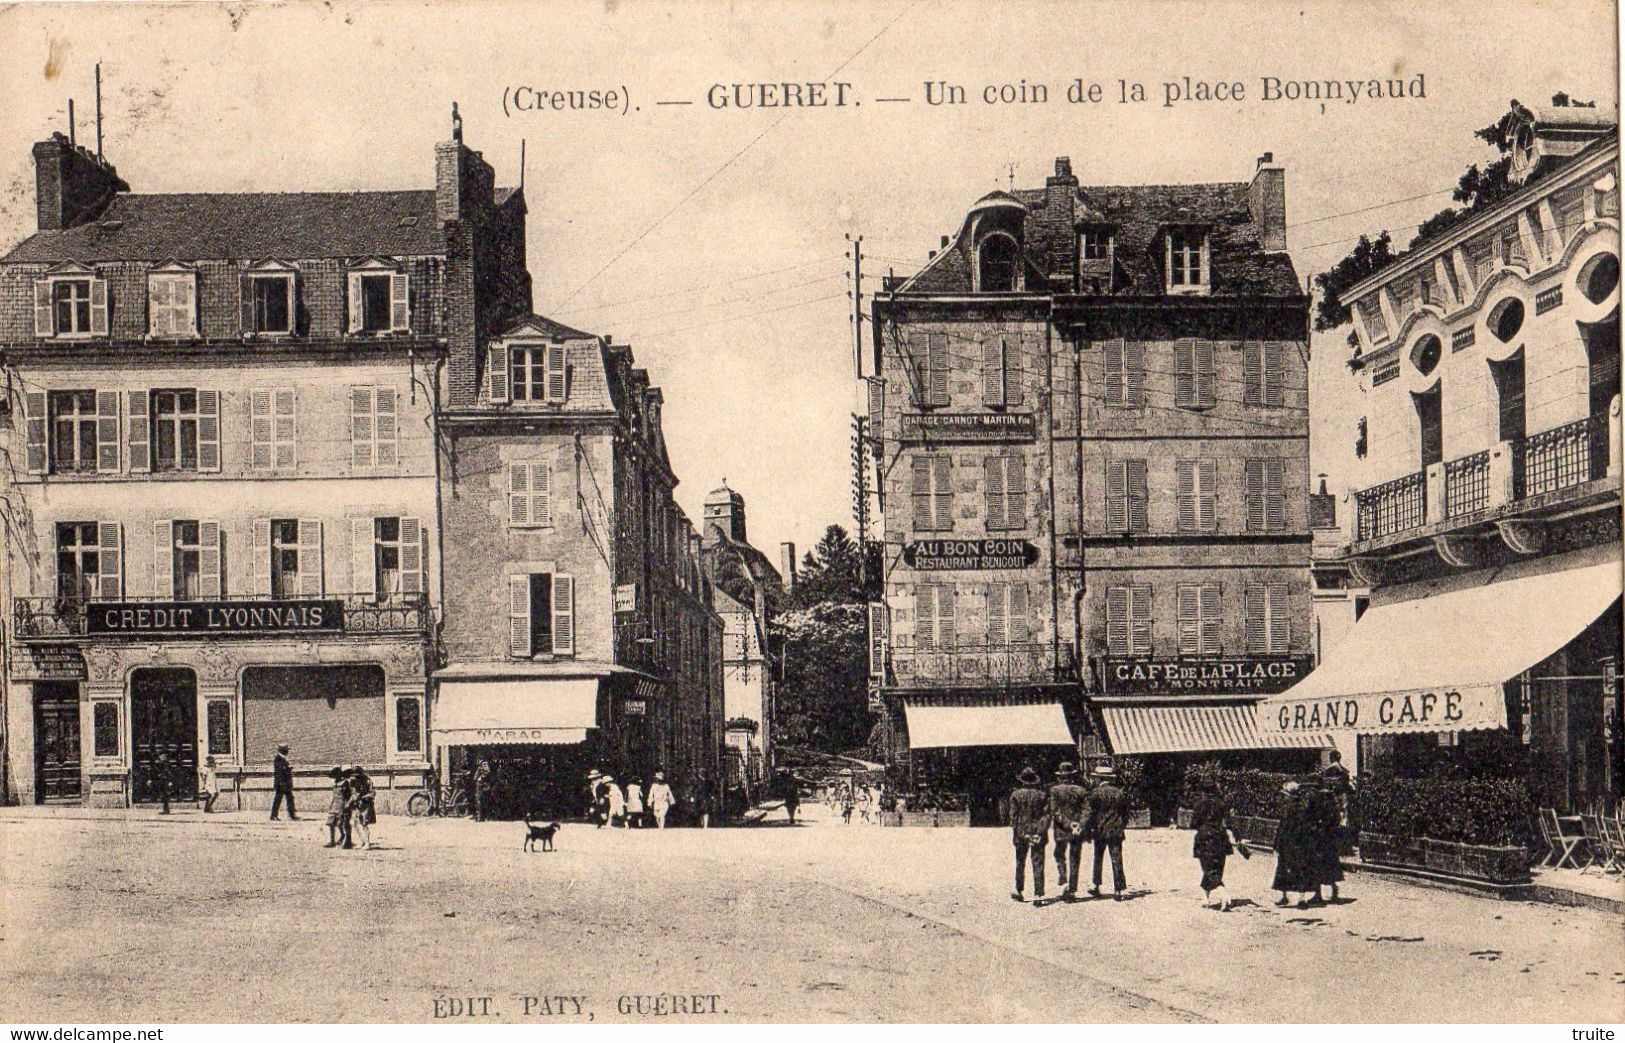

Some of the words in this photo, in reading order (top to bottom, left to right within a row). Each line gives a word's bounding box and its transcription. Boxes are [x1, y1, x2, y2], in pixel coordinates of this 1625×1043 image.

[943, 415, 978, 425] CARNOT
[983, 414, 1016, 425] MARTIN
[915, 541, 939, 555] AU
[943, 541, 980, 555] BON
[984, 540, 1024, 554] COIN
[915, 557, 979, 569] RESTAURANT
[207, 606, 323, 628] LYONNAIS
[1180, 667, 1198, 679] DE
[1171, 679, 1263, 688] MONTRAIT
[1278, 699, 1359, 730] GRAND
[1379, 687, 1463, 725] CAFÉ
